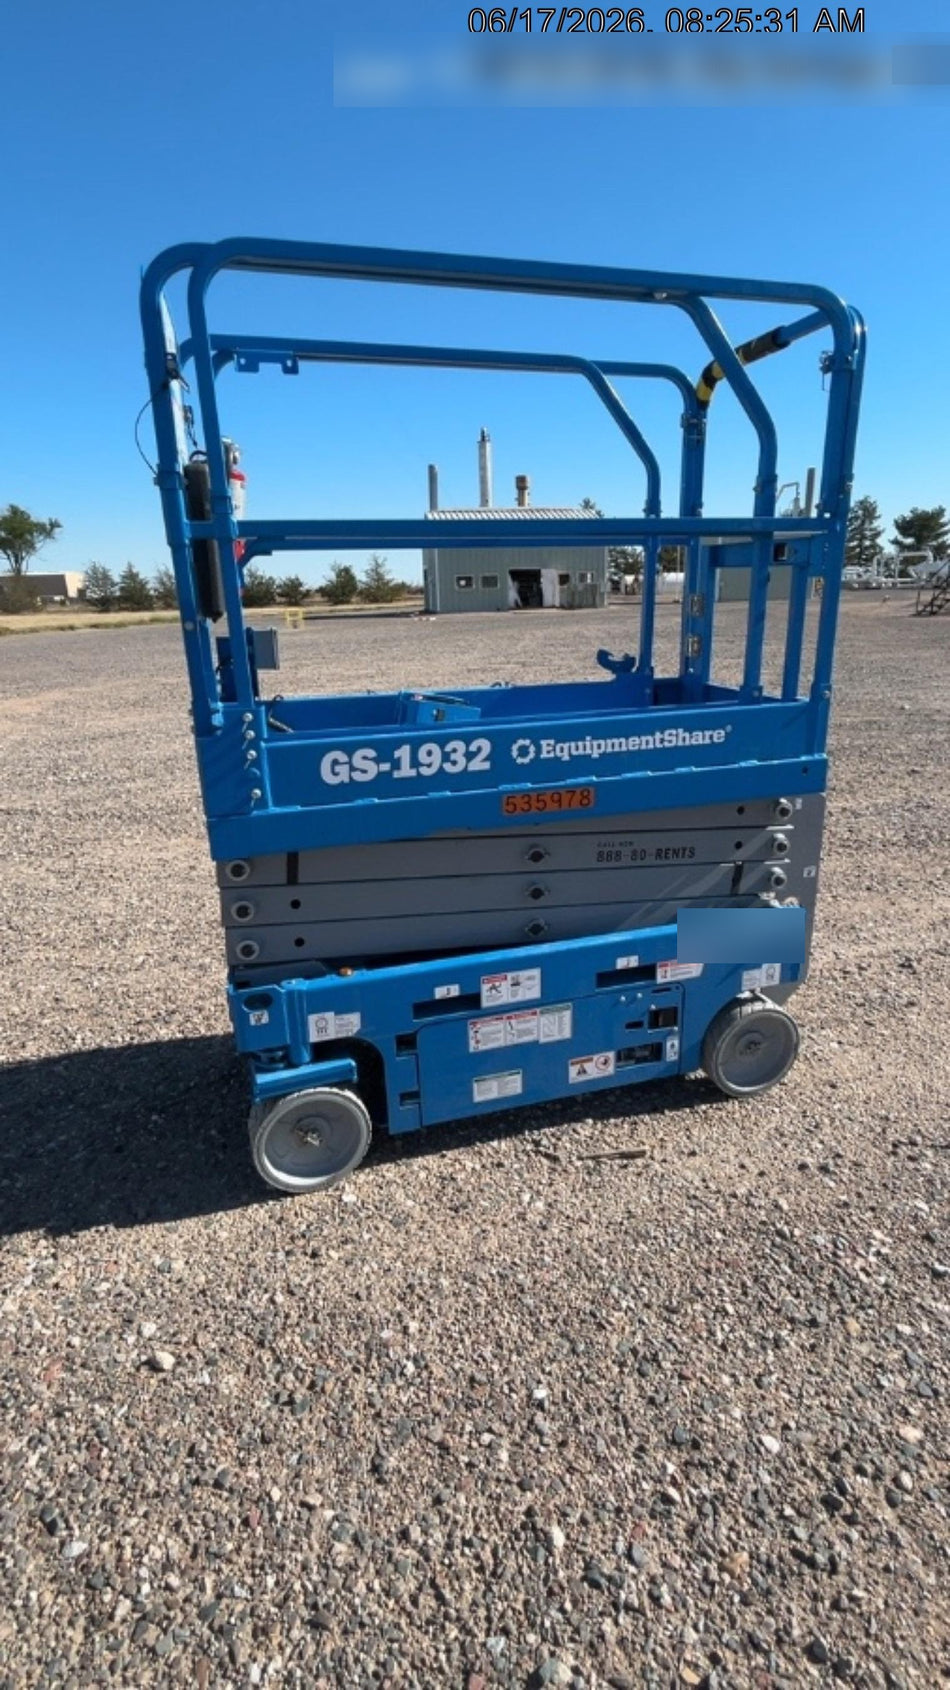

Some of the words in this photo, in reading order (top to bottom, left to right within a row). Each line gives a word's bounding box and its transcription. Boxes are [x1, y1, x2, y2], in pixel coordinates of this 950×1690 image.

[540, 727, 726, 760] EquipmentShare
[320, 738, 491, 785] GS-1932
[505, 789, 592, 814] 535978
[596, 846, 696, 862] 888-80-RENTS
